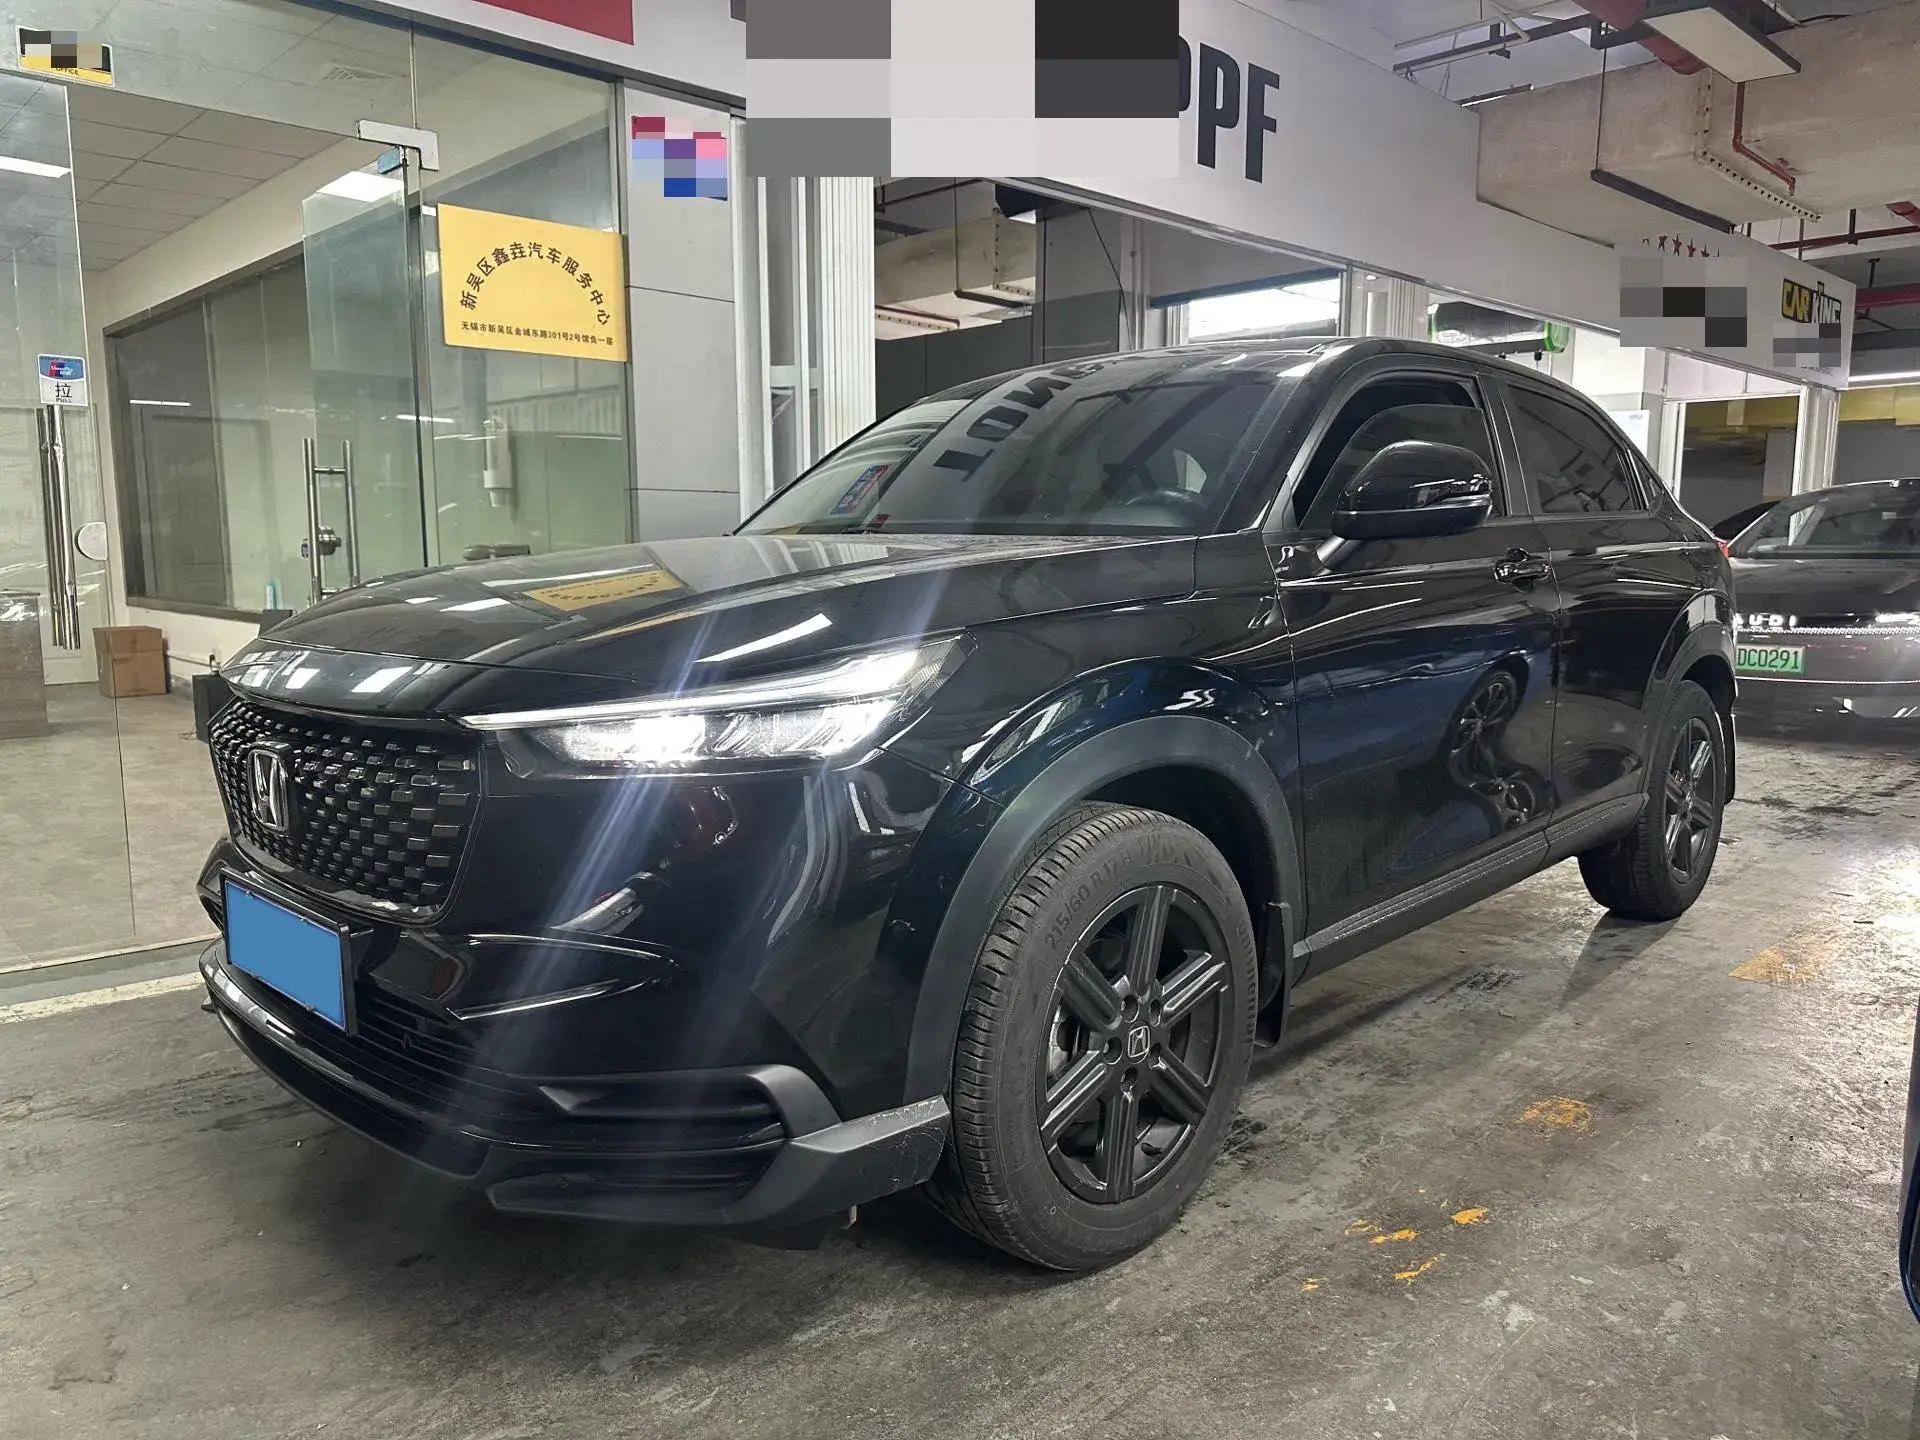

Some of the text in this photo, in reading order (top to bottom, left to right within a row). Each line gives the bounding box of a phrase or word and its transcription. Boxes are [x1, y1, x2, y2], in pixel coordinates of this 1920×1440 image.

[460, 241, 611, 326] 新吴区鑫垚汽车服务中心
[54, 382, 73, 398] 拉
[1044, 886, 1091, 949] 215/60
[1089, 870, 1102, 886] R
